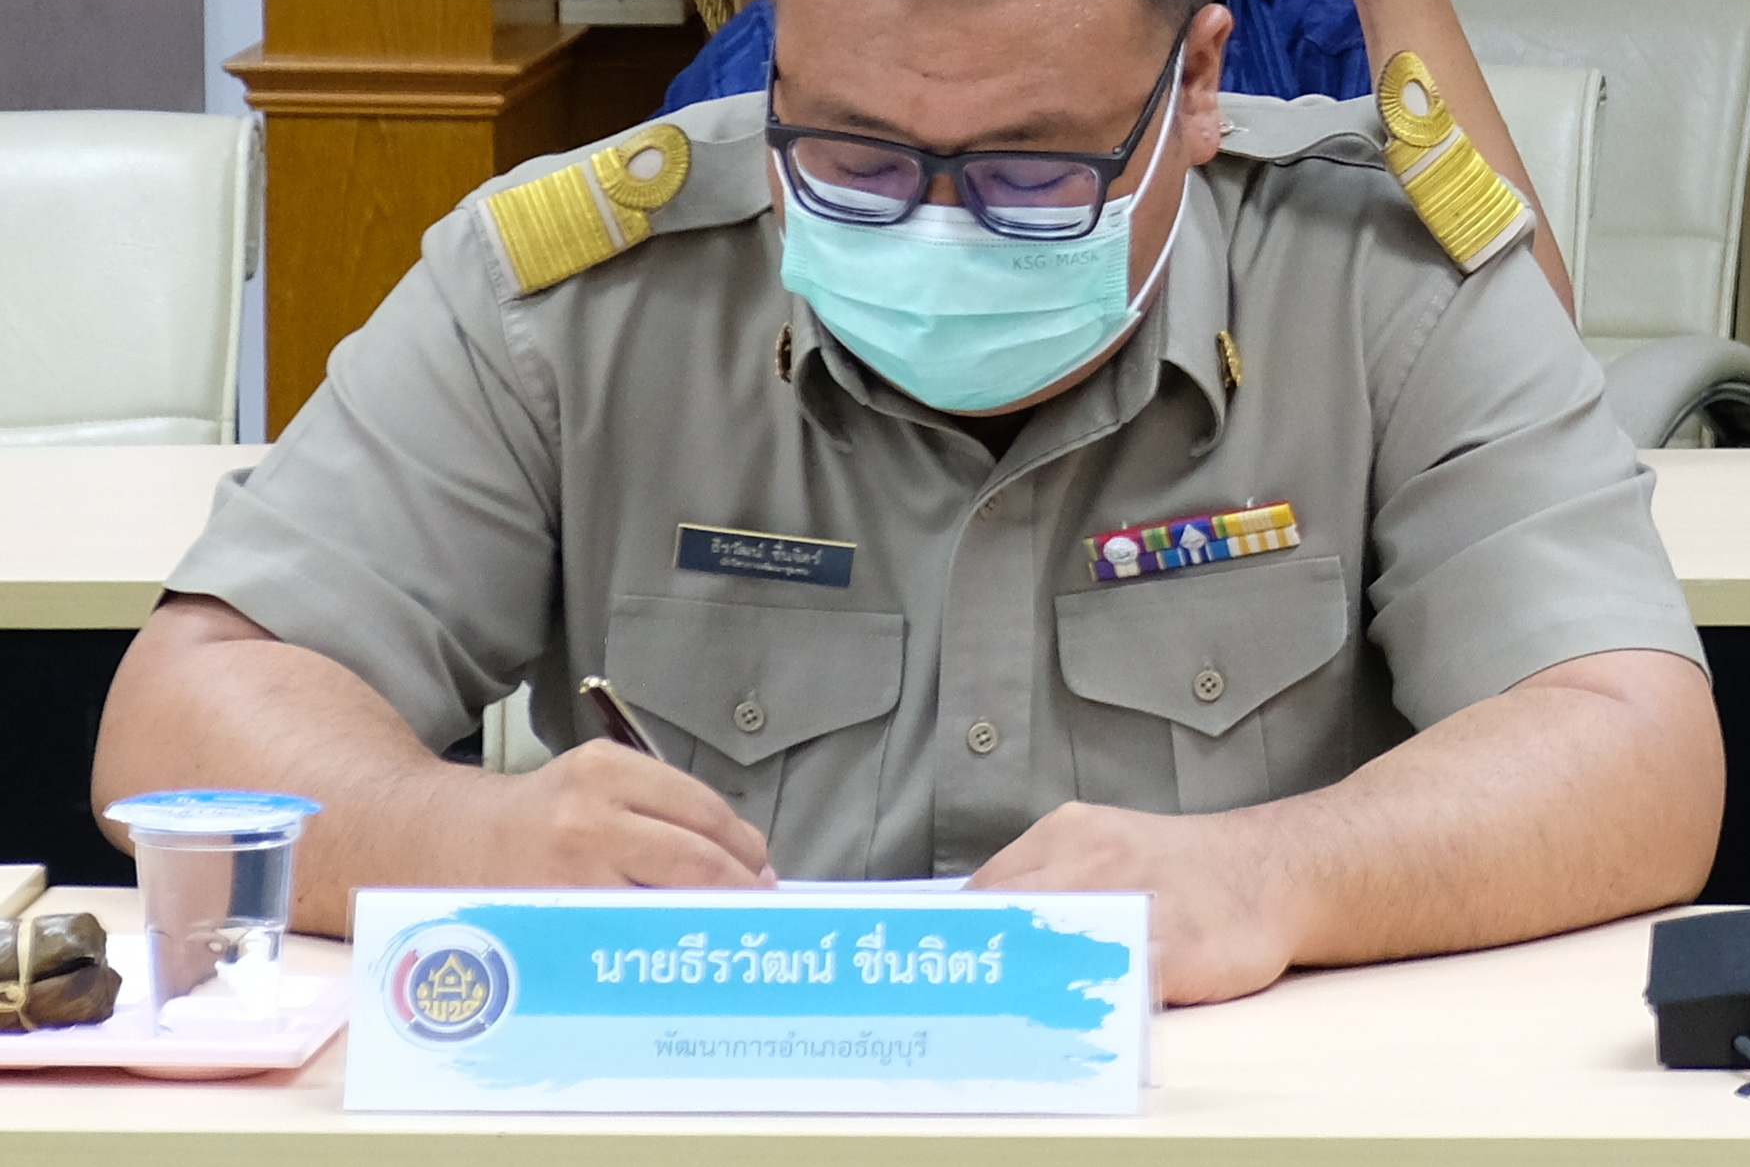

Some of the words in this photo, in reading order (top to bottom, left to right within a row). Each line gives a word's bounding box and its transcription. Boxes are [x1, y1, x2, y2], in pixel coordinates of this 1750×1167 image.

[1012, 255, 1046, 270] KSG
[1056, 251, 1098, 266] MASK
[590, 931, 838, 985] นายธีรวัฒน์
[853, 921, 1005, 984] ชื่นจิตร์
[655, 1029, 928, 1066] พัฒนาการอำเภอธัญบุรี
